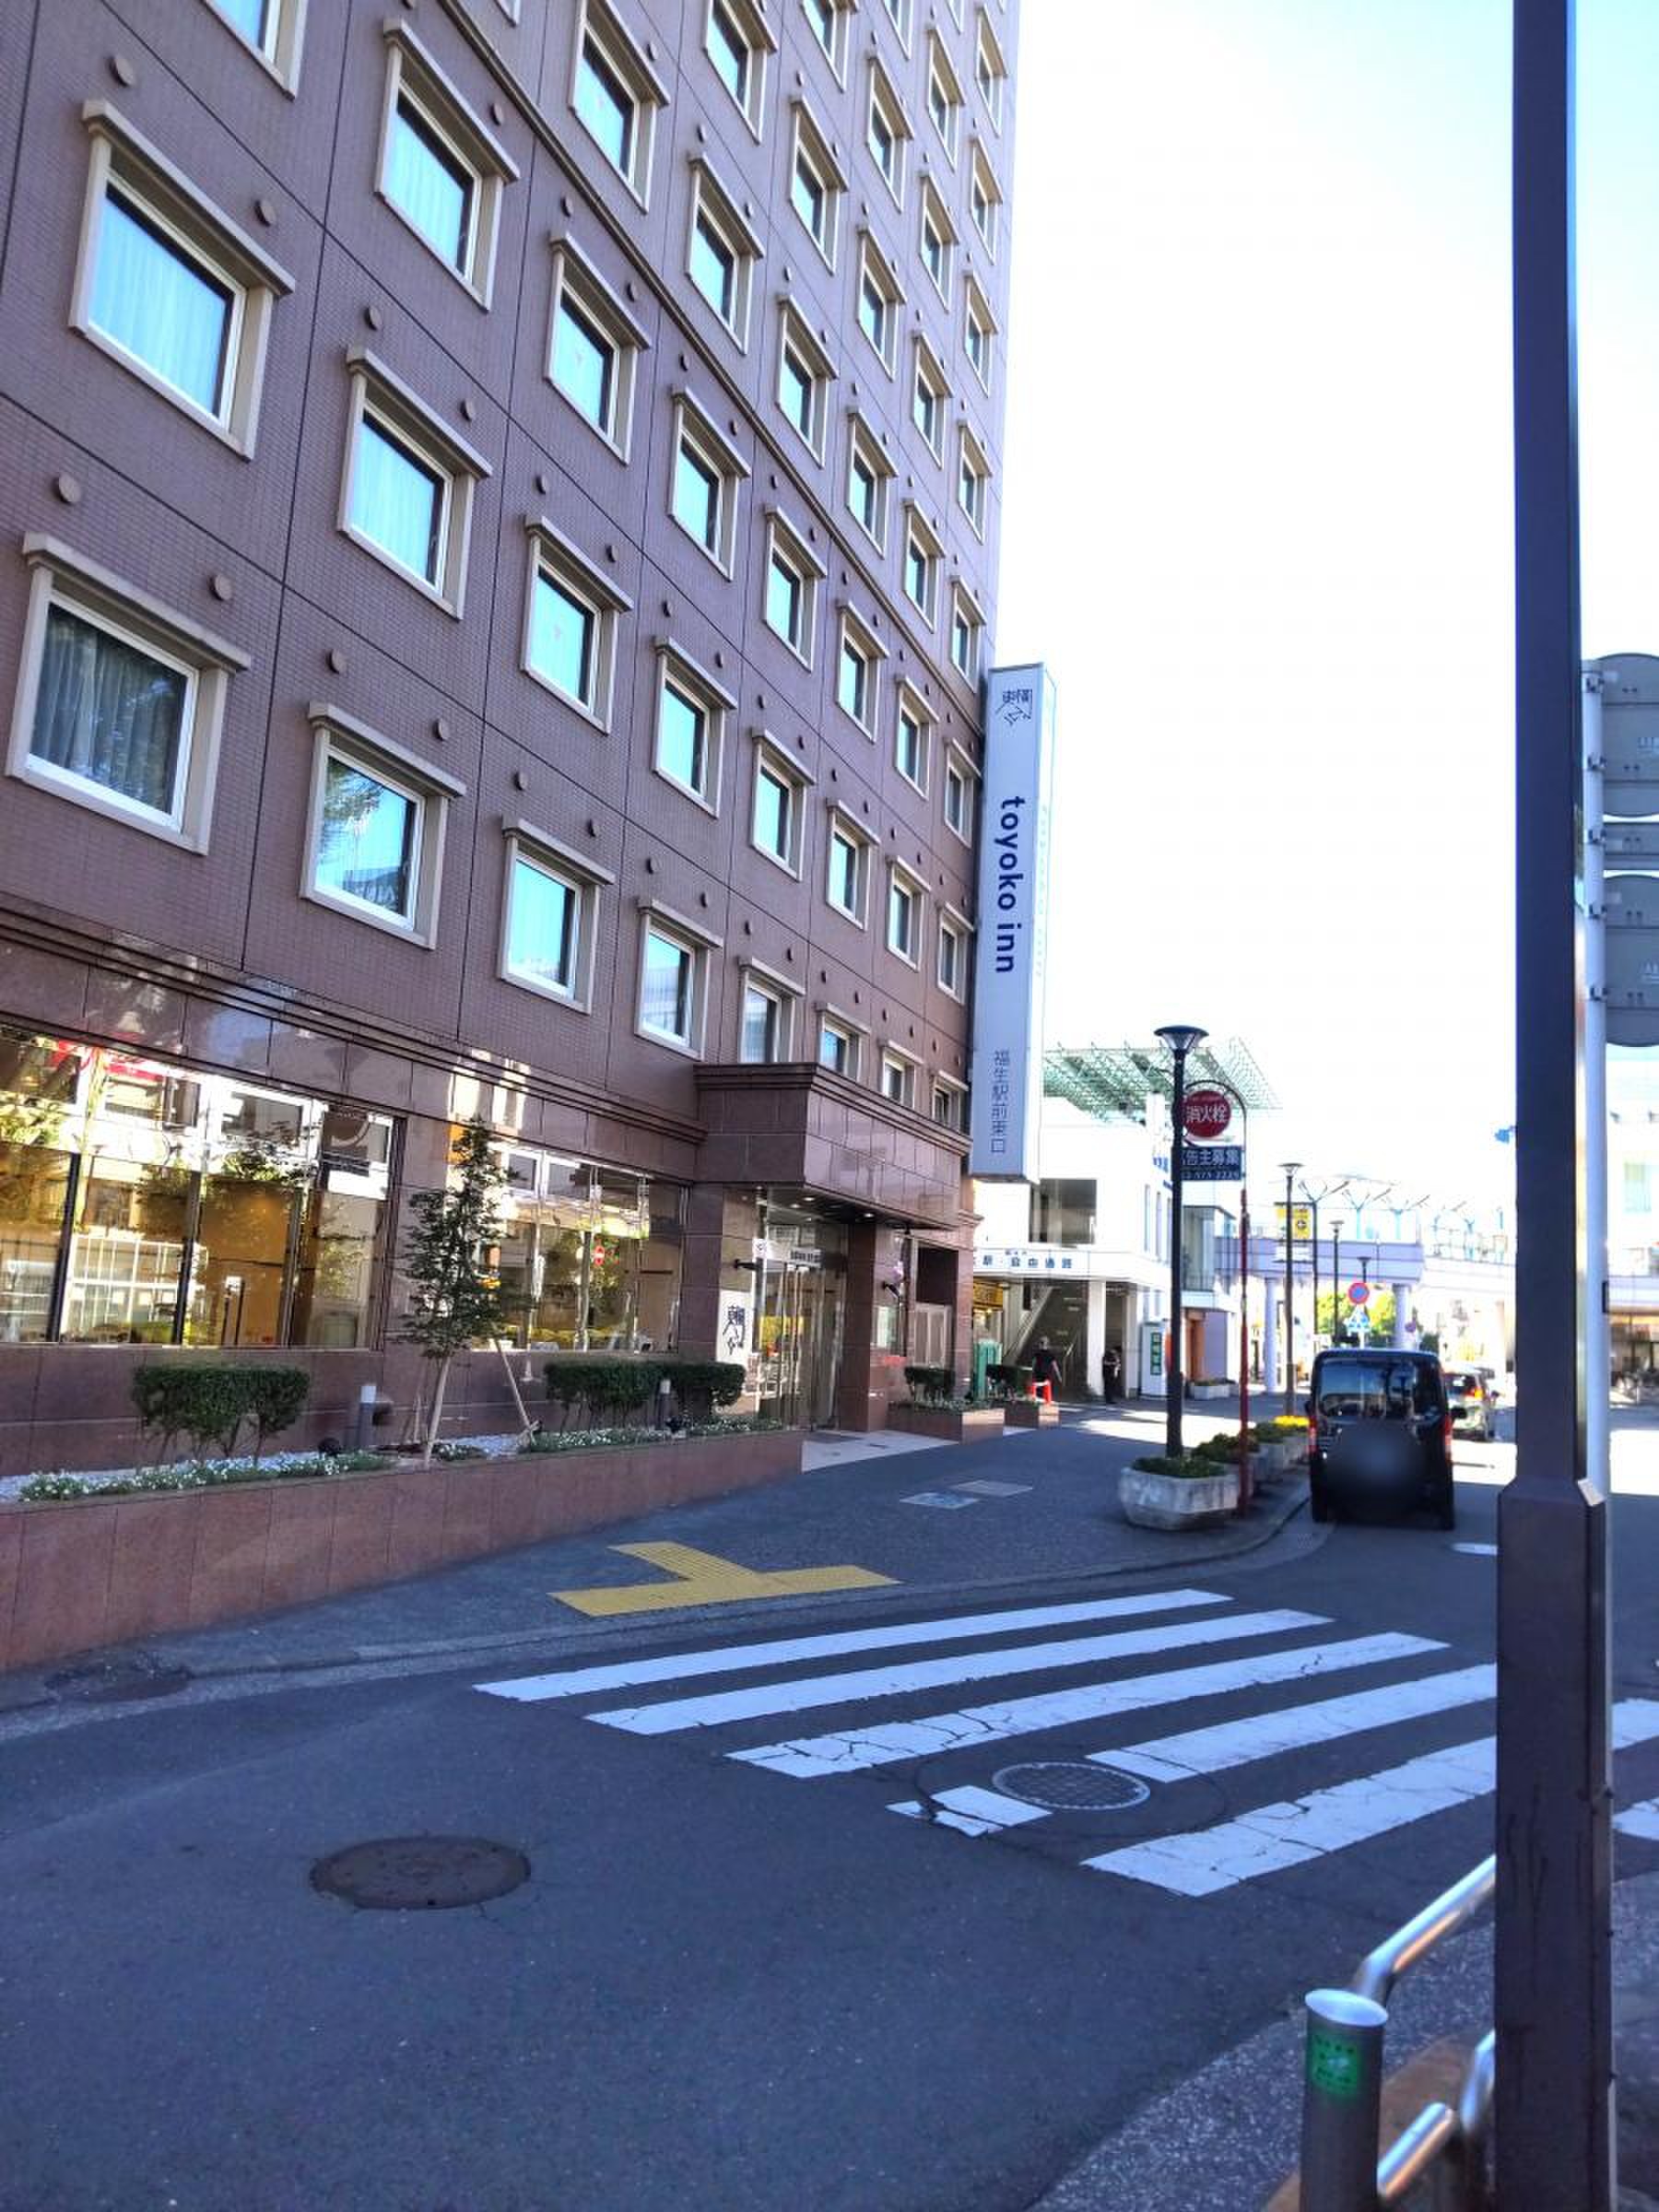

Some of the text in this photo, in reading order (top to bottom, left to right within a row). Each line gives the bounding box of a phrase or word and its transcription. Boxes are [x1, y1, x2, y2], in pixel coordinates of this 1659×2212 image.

[994, 795, 1026, 973] toyoko inn
[1185, 1103, 1228, 1124] 消火栓
